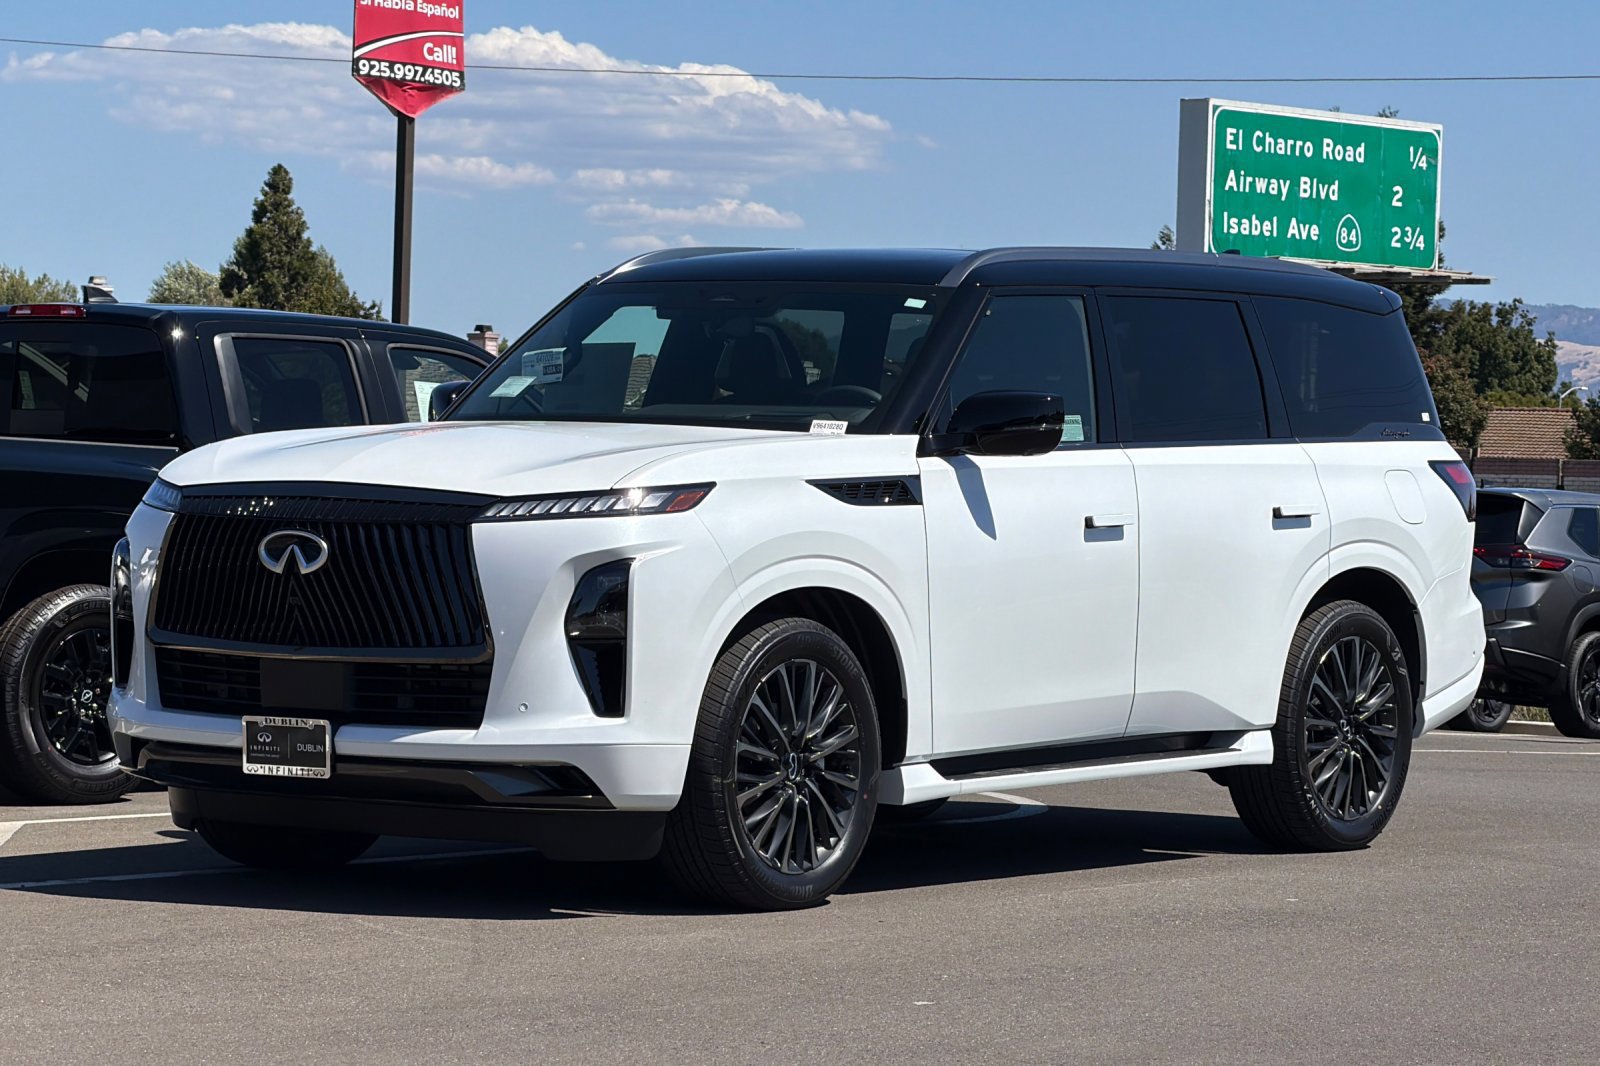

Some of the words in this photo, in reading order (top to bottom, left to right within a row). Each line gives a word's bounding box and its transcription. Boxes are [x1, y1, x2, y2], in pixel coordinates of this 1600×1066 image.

[417, 0, 459, 19] Español
[423, 42, 457, 64] Call!
[358, 59, 461, 87] 925.997.4505
[1225, 127, 1243, 151] El
[1252, 130, 1313, 158] Charro
[1322, 137, 1365, 163] Road
[1224, 169, 1290, 201] Airway
[1300, 177, 1339, 201] Blvd
[1391, 185, 1403, 207] 2
[1223, 212, 1278, 238] Isabel
[1287, 217, 1320, 241] Ave
[1340, 227, 1357, 245] 84
[264, 717, 308, 726] DUBLIN
[297, 744, 323, 752] DUBLIN
[263, 765, 310, 776] INFINITI
